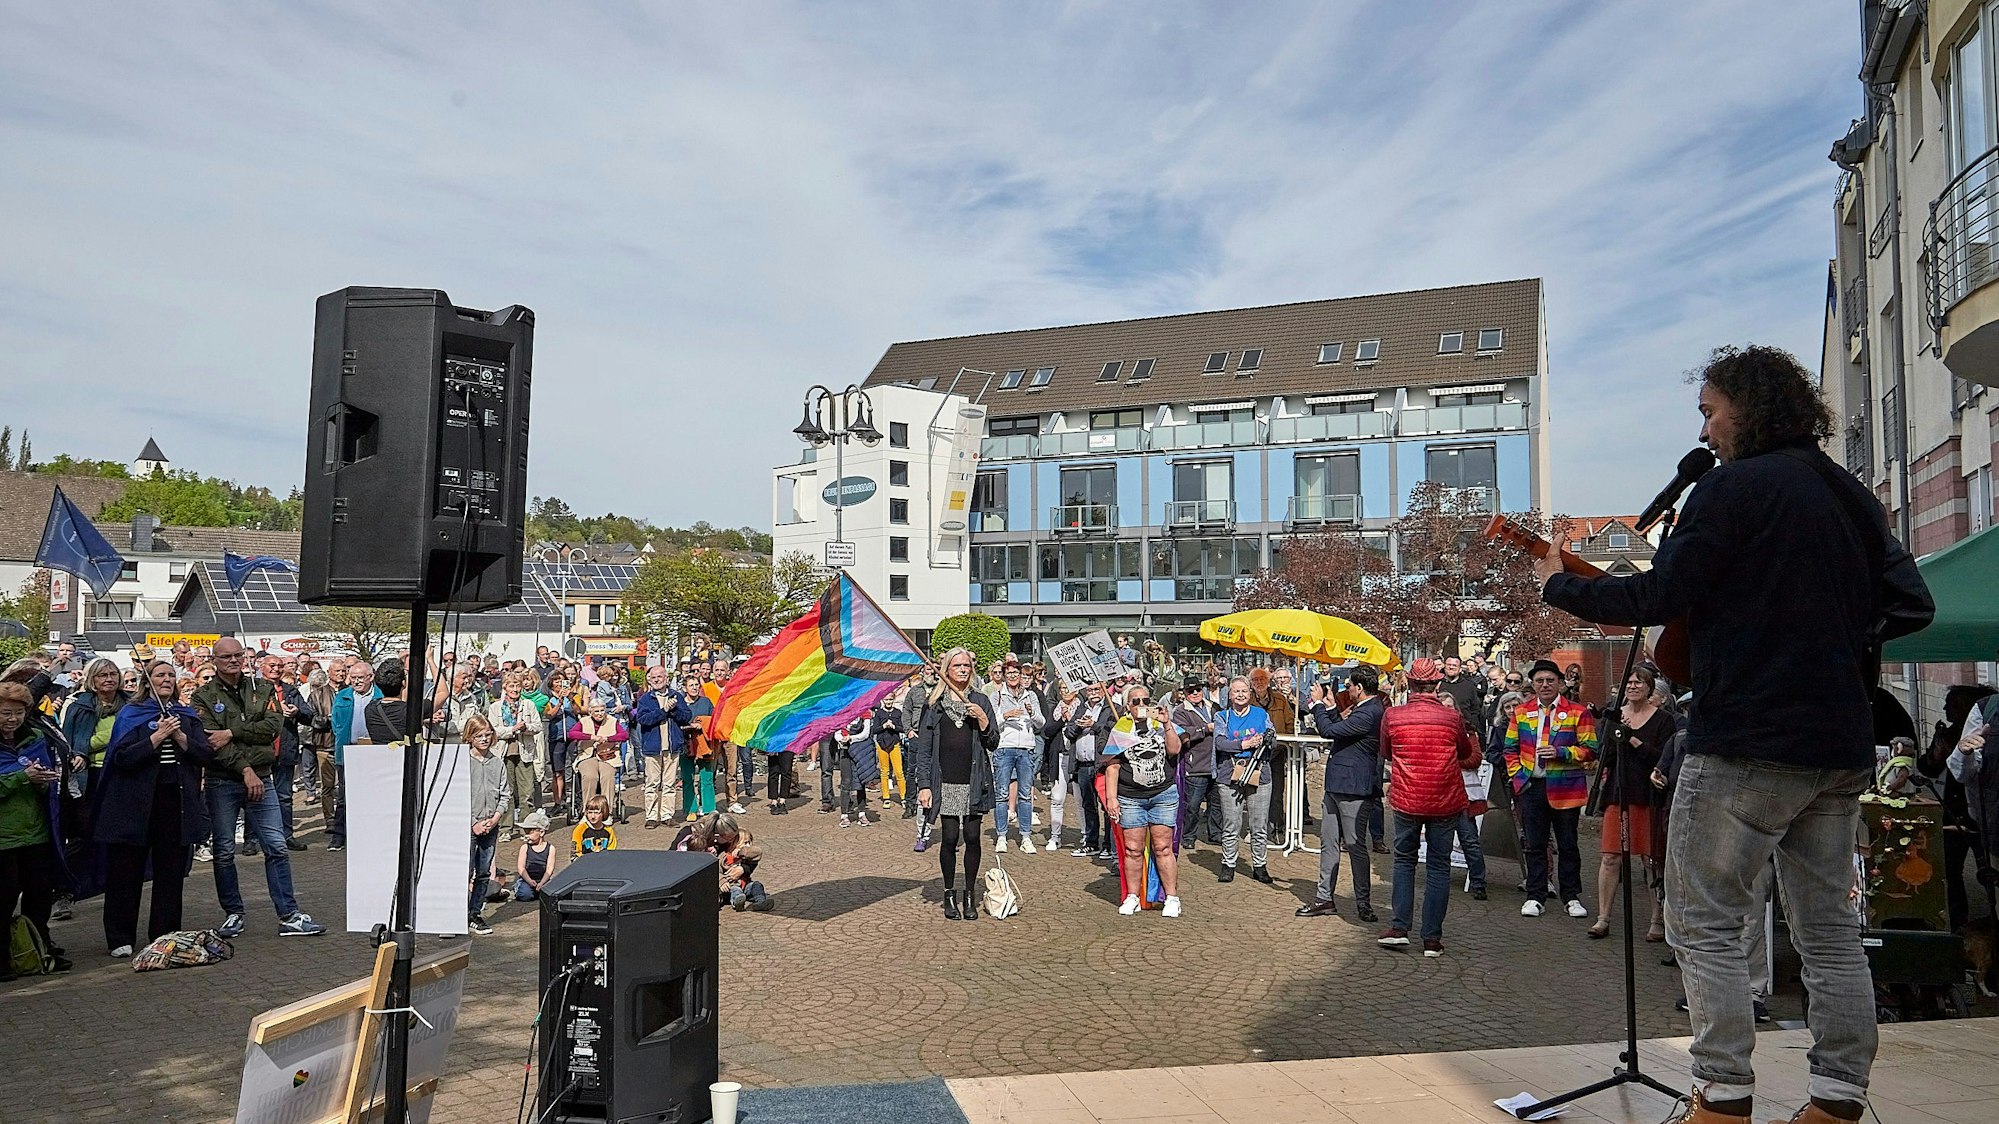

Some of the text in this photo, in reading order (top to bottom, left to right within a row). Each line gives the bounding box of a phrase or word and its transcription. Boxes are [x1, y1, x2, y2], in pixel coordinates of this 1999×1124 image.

[823, 481, 876, 497] BRUENPASSAGE
[150, 637, 175, 646] Eifel
[1271, 632, 1302, 644] UWV
[1054, 644, 1077, 659] BJÖRN
[1344, 643, 1369, 654] UWV
[1059, 653, 1082, 668] HÖCKE
[1066, 665, 1091, 683] NAZI
